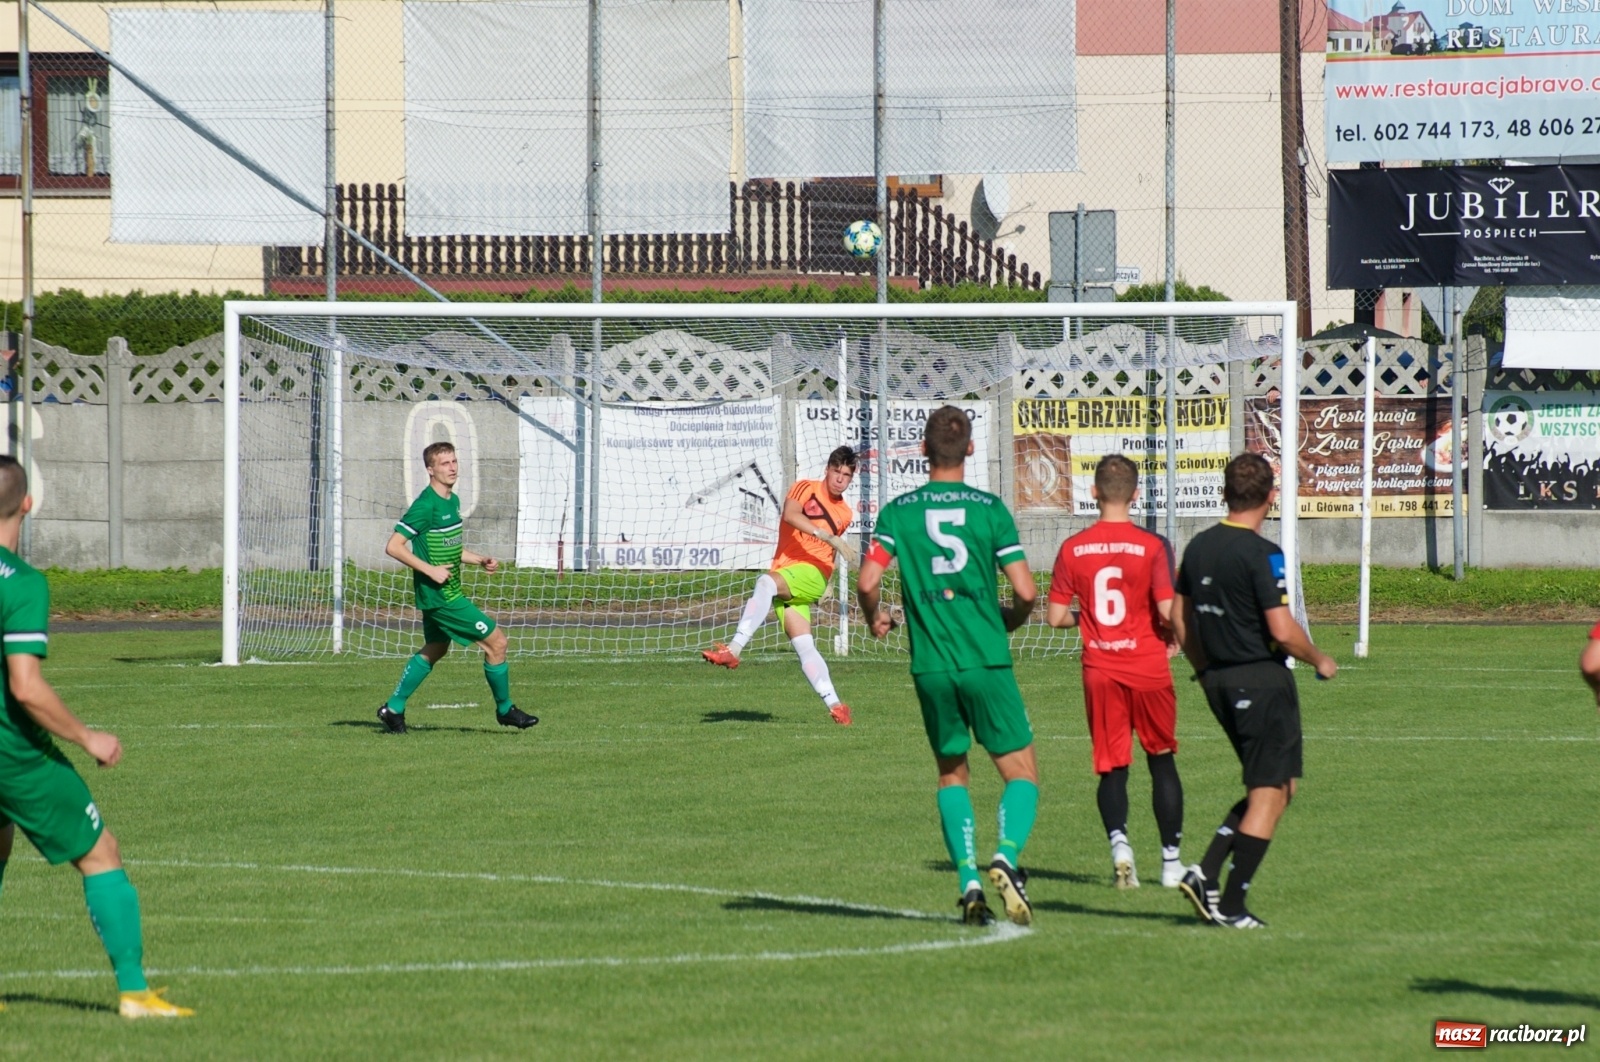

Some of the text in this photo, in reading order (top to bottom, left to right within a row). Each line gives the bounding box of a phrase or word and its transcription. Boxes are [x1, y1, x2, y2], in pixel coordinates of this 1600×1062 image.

[1336, 124, 1366, 141] tel.
[1374, 123, 1409, 141] 602
[1416, 122, 1451, 139] 744
[1460, 120, 1500, 139] 173,
[1507, 119, 1531, 137] 48
[1539, 118, 1574, 136] 606
[1464, 227, 1537, 239] POŚPIECH
[1017, 399, 1229, 430] OKNA-DRZWI-SHODY
[1538, 404, 1582, 418] JEDEN
[1316, 463, 1423, 476] pizzeria catering
[1202, 486, 1214, 495] 62
[1301, 501, 1314, 512] ul.
[1316, 500, 1355, 512] Główna
[1381, 502, 1396, 512] tel.
[1399, 501, 1418, 511] 798
[1421, 500, 1439, 511] 441
[925, 508, 969, 575] 5
[616, 548, 646, 566] 604
[652, 548, 683, 566] 507
[690, 548, 720, 566] 320
[1094, 566, 1127, 627] 6
[475, 620, 489, 634] 9
[85, 802, 100, 831] 3
